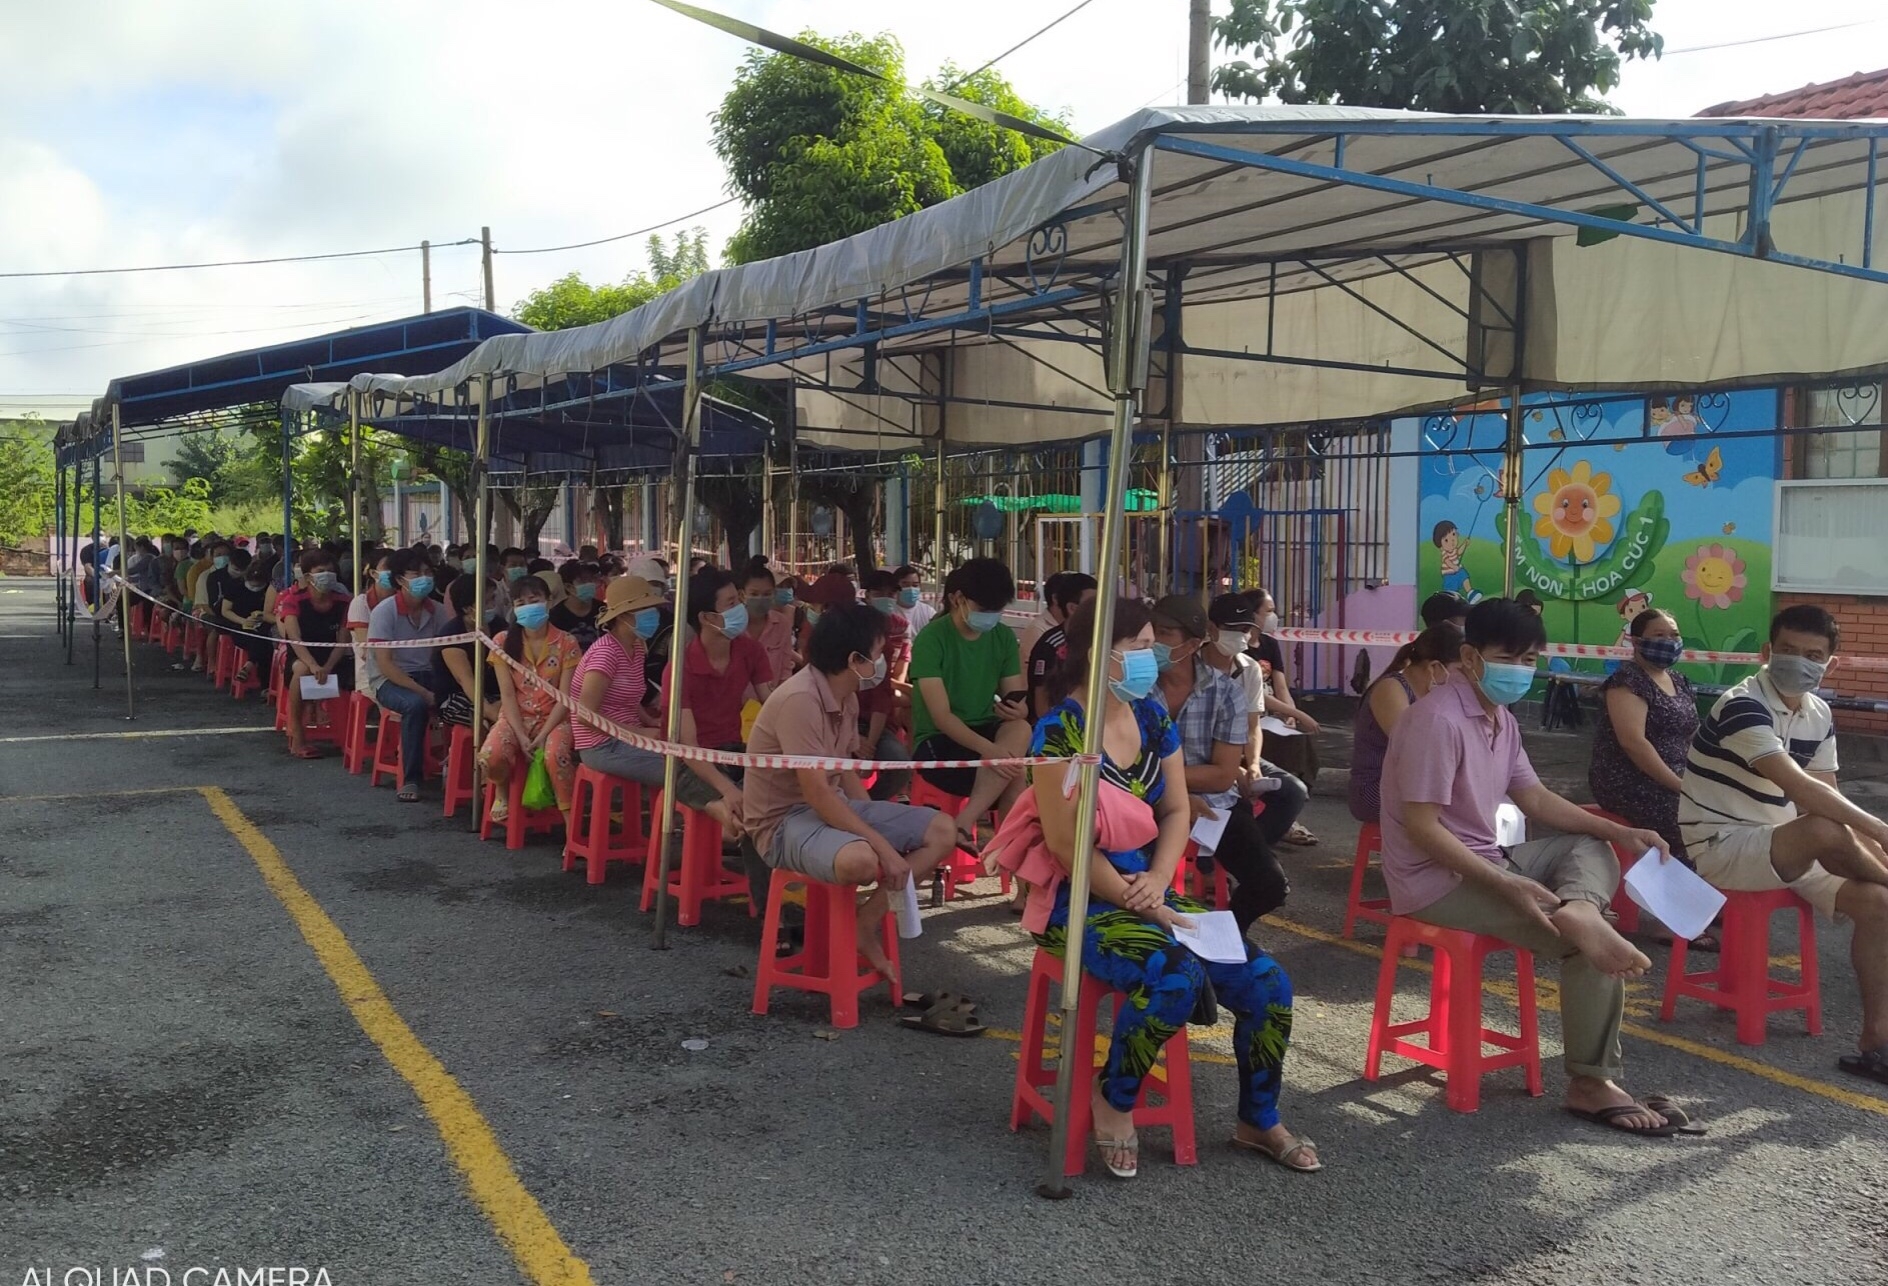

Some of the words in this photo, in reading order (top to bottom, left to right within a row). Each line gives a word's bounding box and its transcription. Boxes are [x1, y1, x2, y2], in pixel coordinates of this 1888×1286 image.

[1526, 566, 1563, 596] NON
[1582, 570, 1623, 598] HOA
[1622, 531, 1649, 570] CÚC
[1639, 516, 1654, 525] 1
